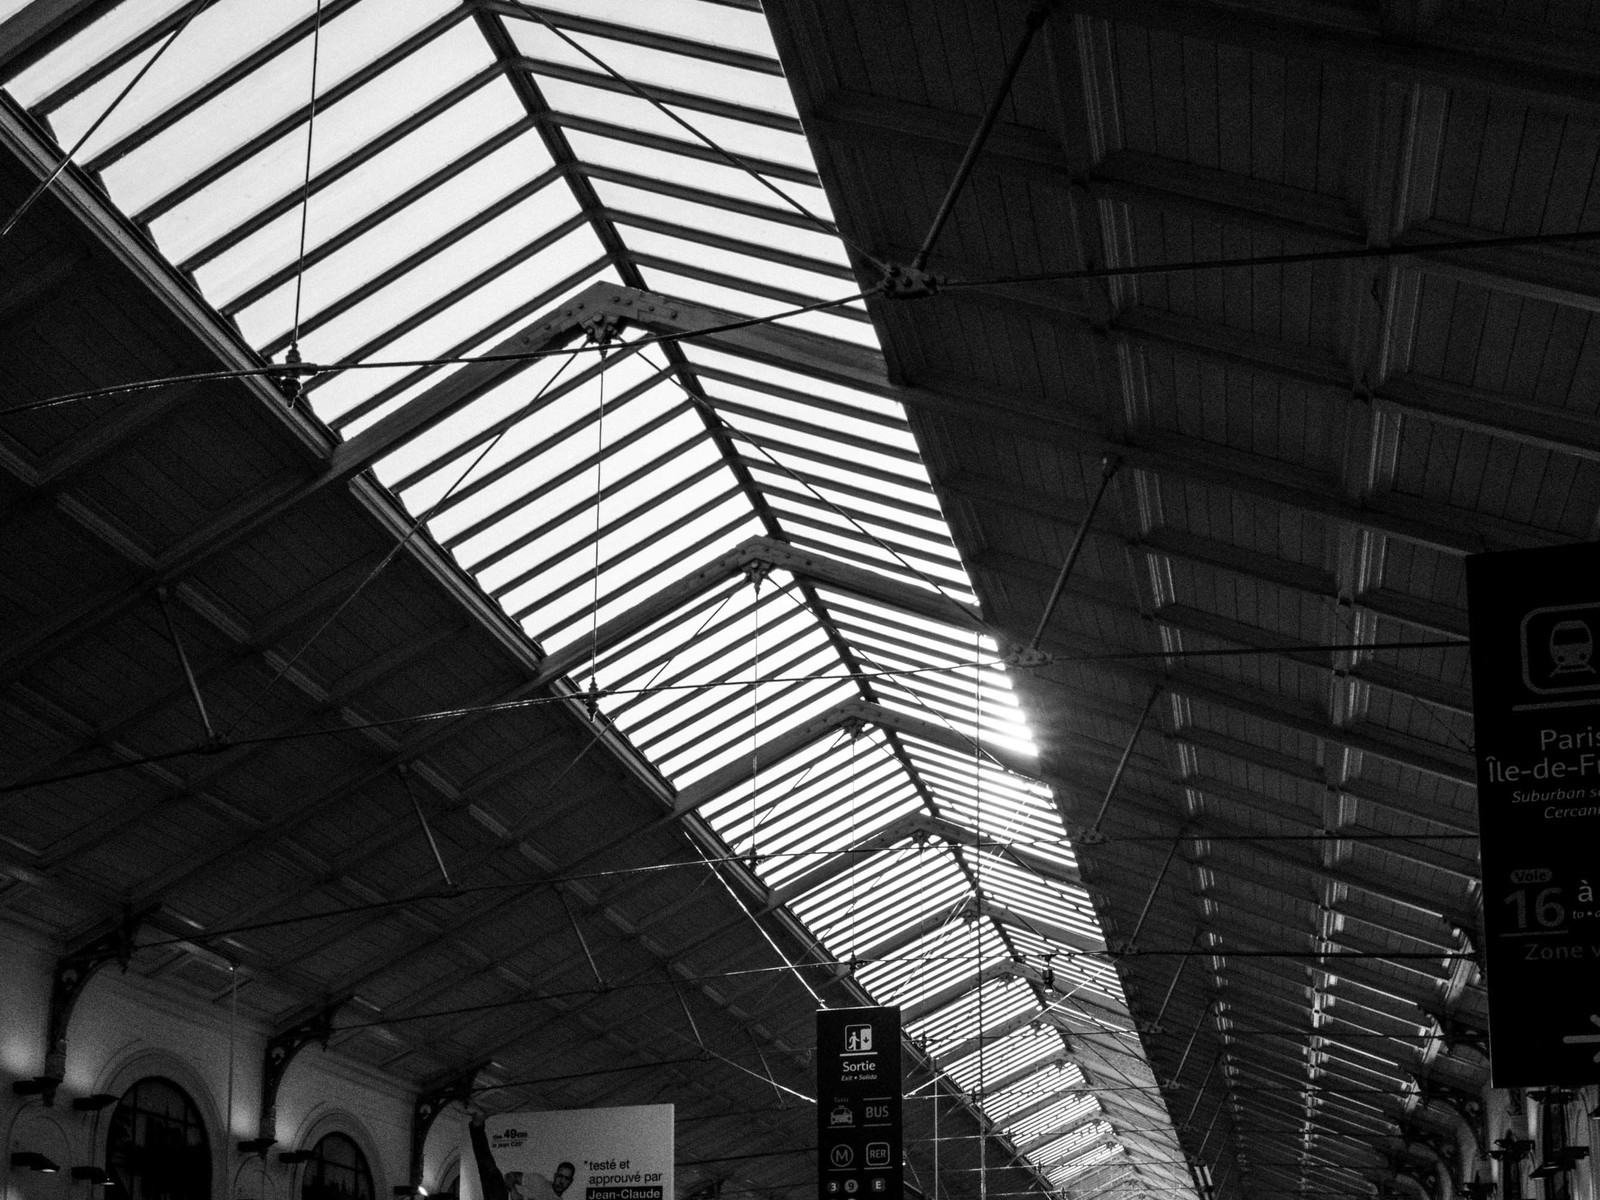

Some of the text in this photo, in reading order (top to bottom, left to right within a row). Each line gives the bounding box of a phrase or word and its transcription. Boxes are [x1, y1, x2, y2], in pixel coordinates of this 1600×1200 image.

[1512, 788, 1586, 804] Suburban
[1515, 871, 1547, 882] Voie
[1577, 878, 1593, 903] à
[1503, 887, 1566, 928] 16
[1573, 910, 1584, 919] to
[1524, 943, 1583, 961] Zone
[842, 1060, 876, 1072] Sortie
[865, 1105, 889, 1118] BUS
[835, 1149, 849, 1162] M
[869, 1149, 887, 1159] RER
[619, 1159, 630, 1170] et
[588, 1171, 662, 1186] approuvé par
[830, 1181, 855, 1192] 3 9
[875, 1181, 882, 1190] E
[588, 1188, 661, 1200] Jean-Claude
